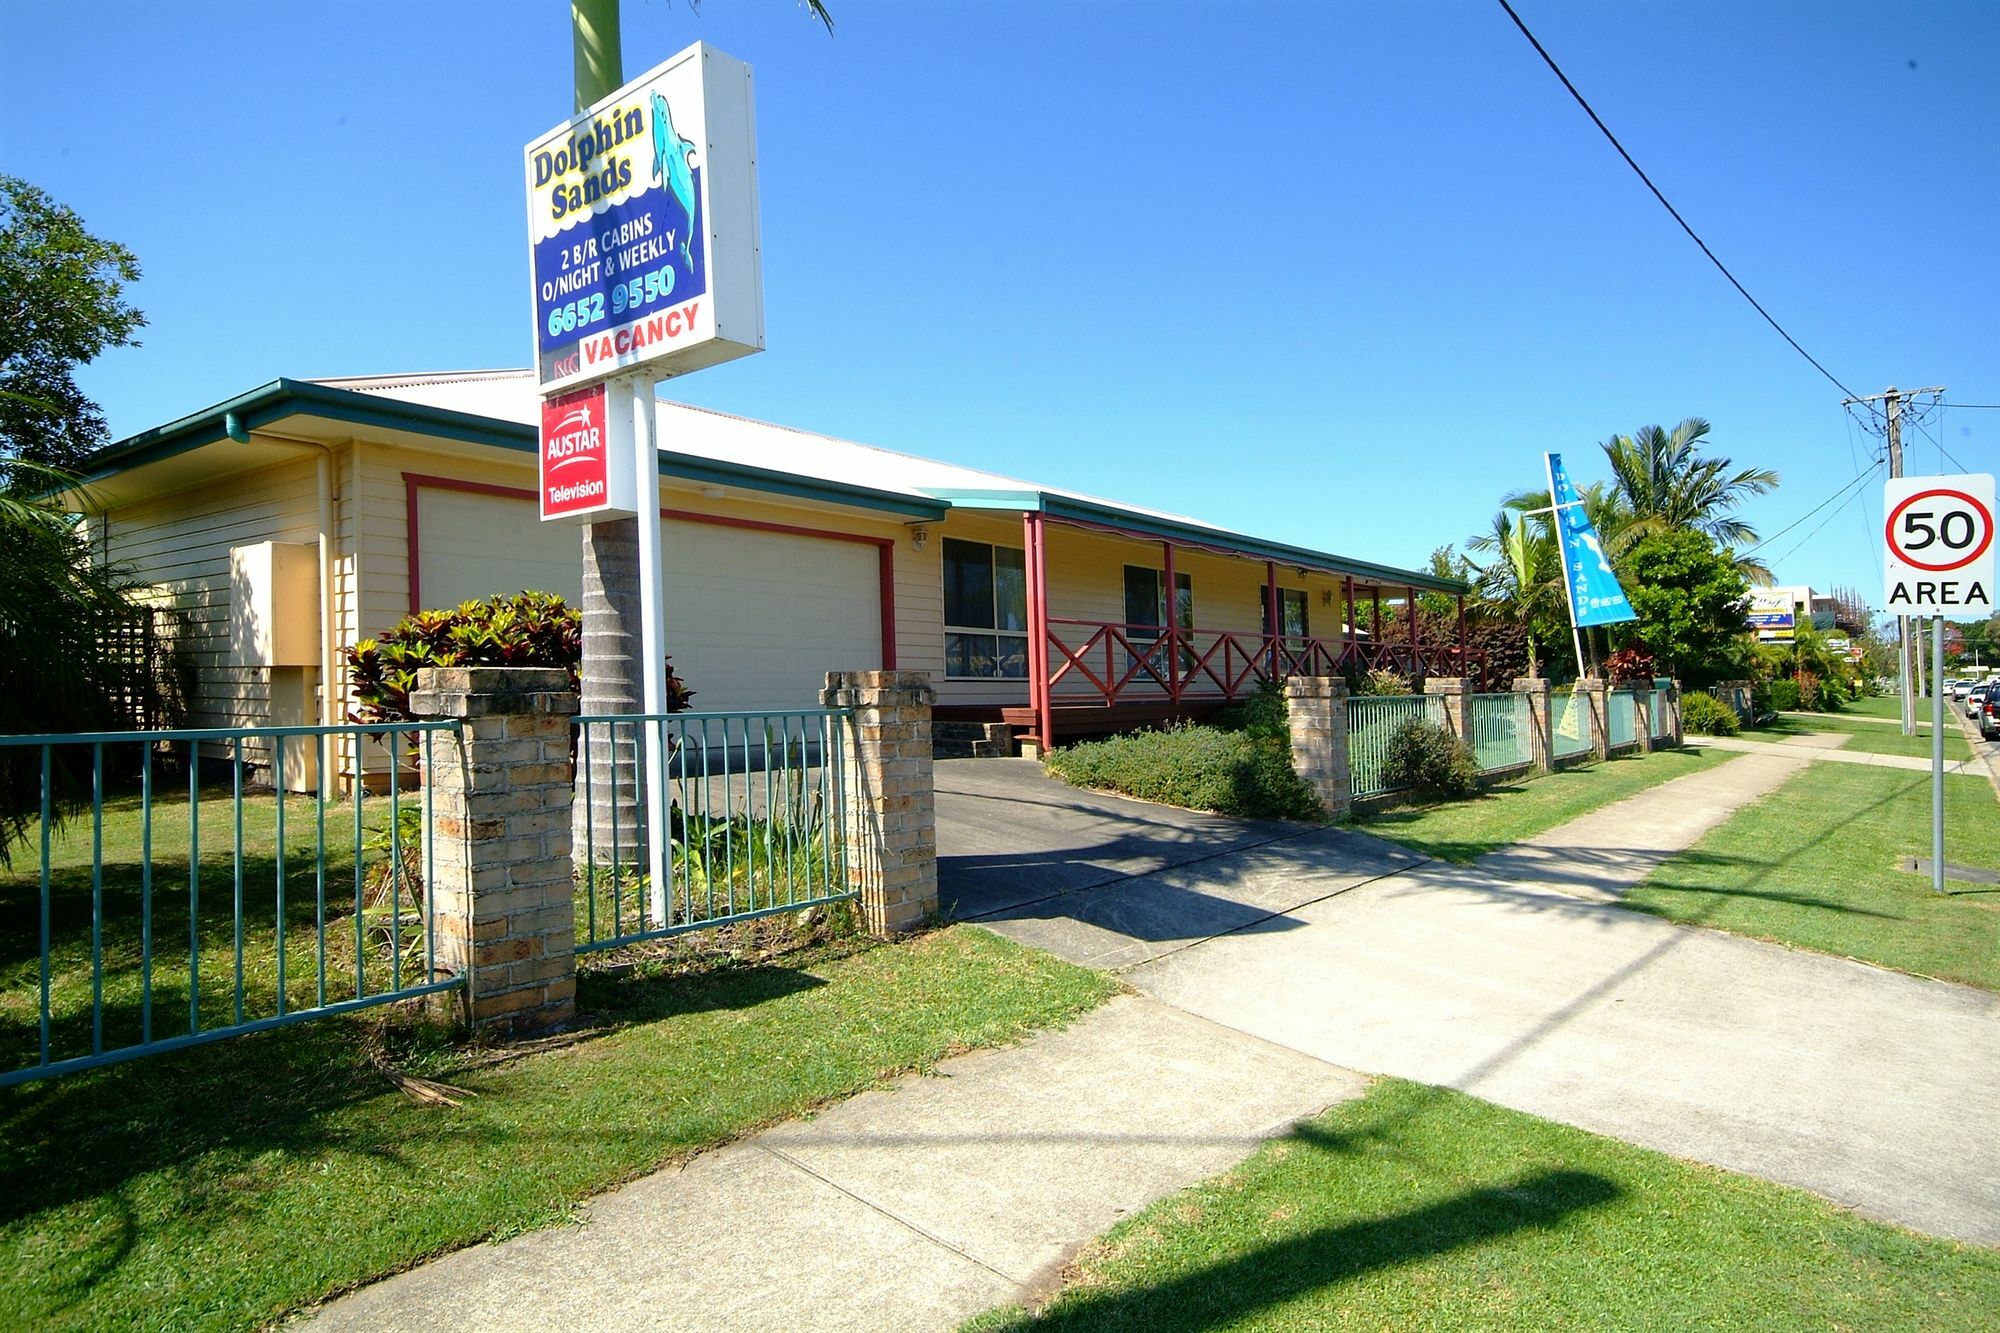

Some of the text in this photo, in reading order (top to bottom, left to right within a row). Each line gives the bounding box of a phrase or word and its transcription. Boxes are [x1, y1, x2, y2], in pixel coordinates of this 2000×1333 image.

[534, 106, 644, 188] Dolphin
[552, 157, 632, 219] Sands
[542, 229, 677, 302] O/NIGHT & WEEKLY
[561, 212, 653, 270] 2 B/R CABINS
[548, 264, 676, 337] 6652 9550
[584, 302, 700, 365] VACANCY
[547, 426, 600, 461] AUSTAR
[548, 478, 604, 504] Television
[1904, 510, 1975, 550] 50
[1888, 581, 1990, 605] AREA
